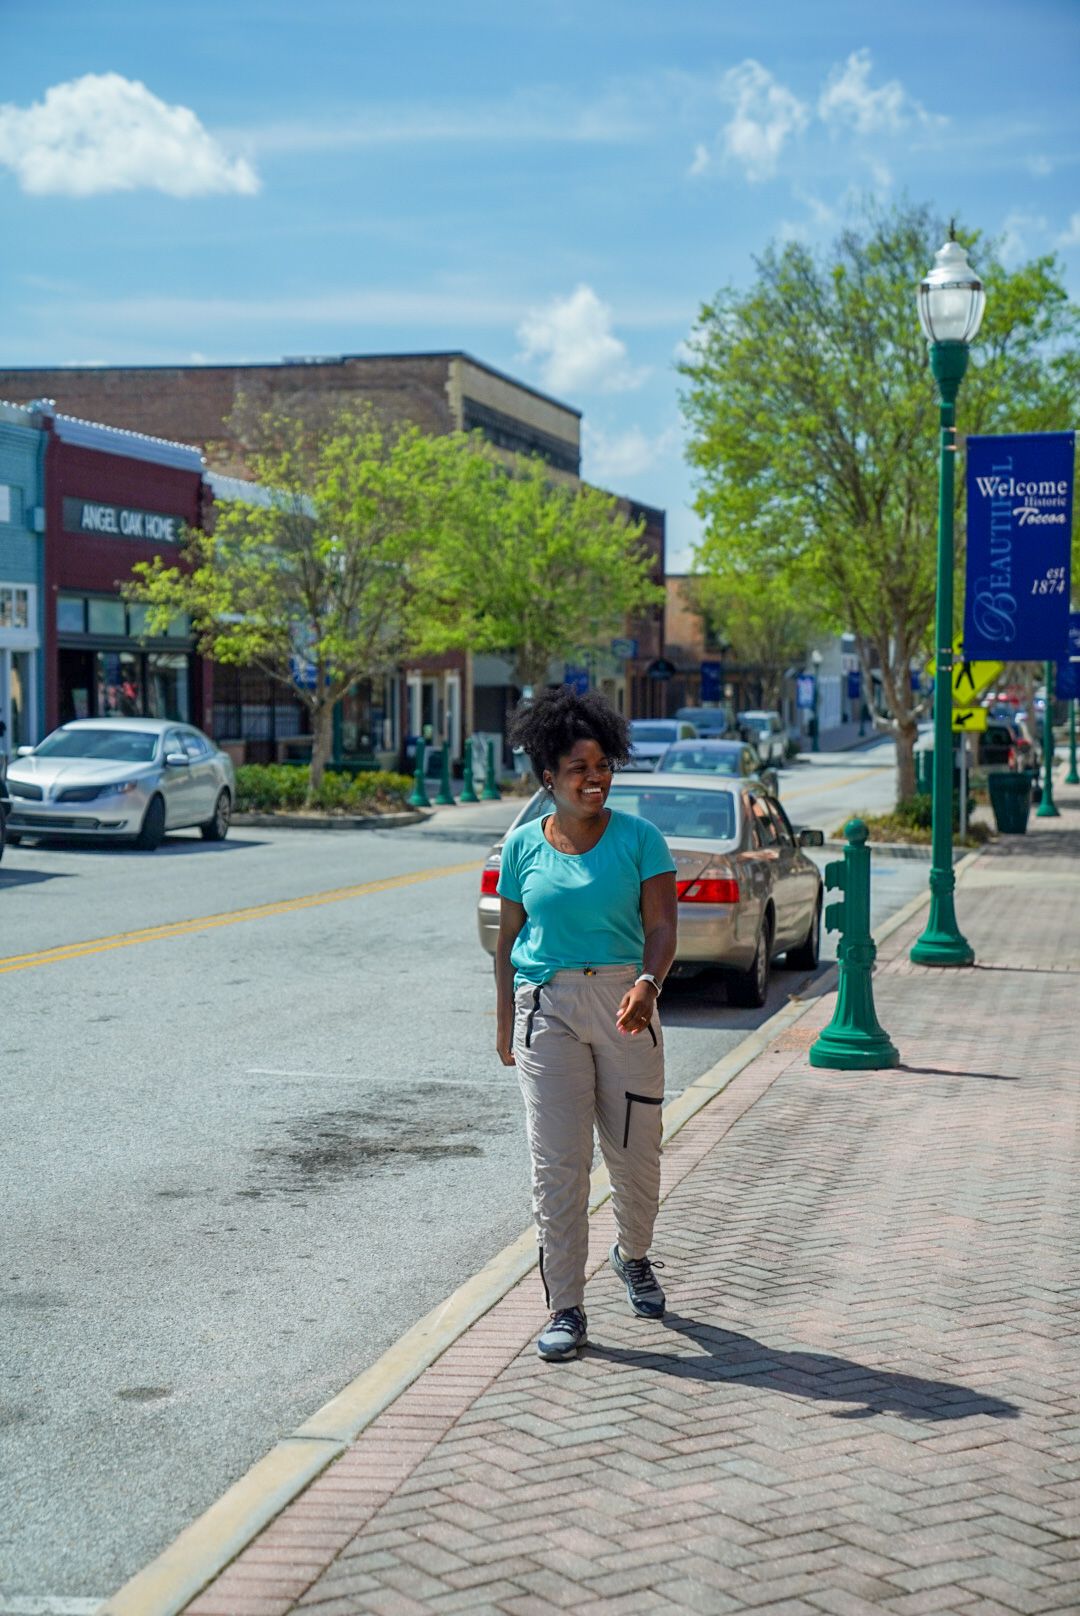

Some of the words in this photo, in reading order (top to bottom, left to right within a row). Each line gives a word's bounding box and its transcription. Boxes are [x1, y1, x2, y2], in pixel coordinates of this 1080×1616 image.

[976, 476, 1068, 497] Welcome
[1024, 496, 1067, 507] Historic
[82, 504, 119, 533] ANGEL
[120, 510, 143, 536] OAK
[145, 514, 175, 542] HOME
[1046, 567, 1065, 579] est
[1031, 579, 1065, 595] 1874
